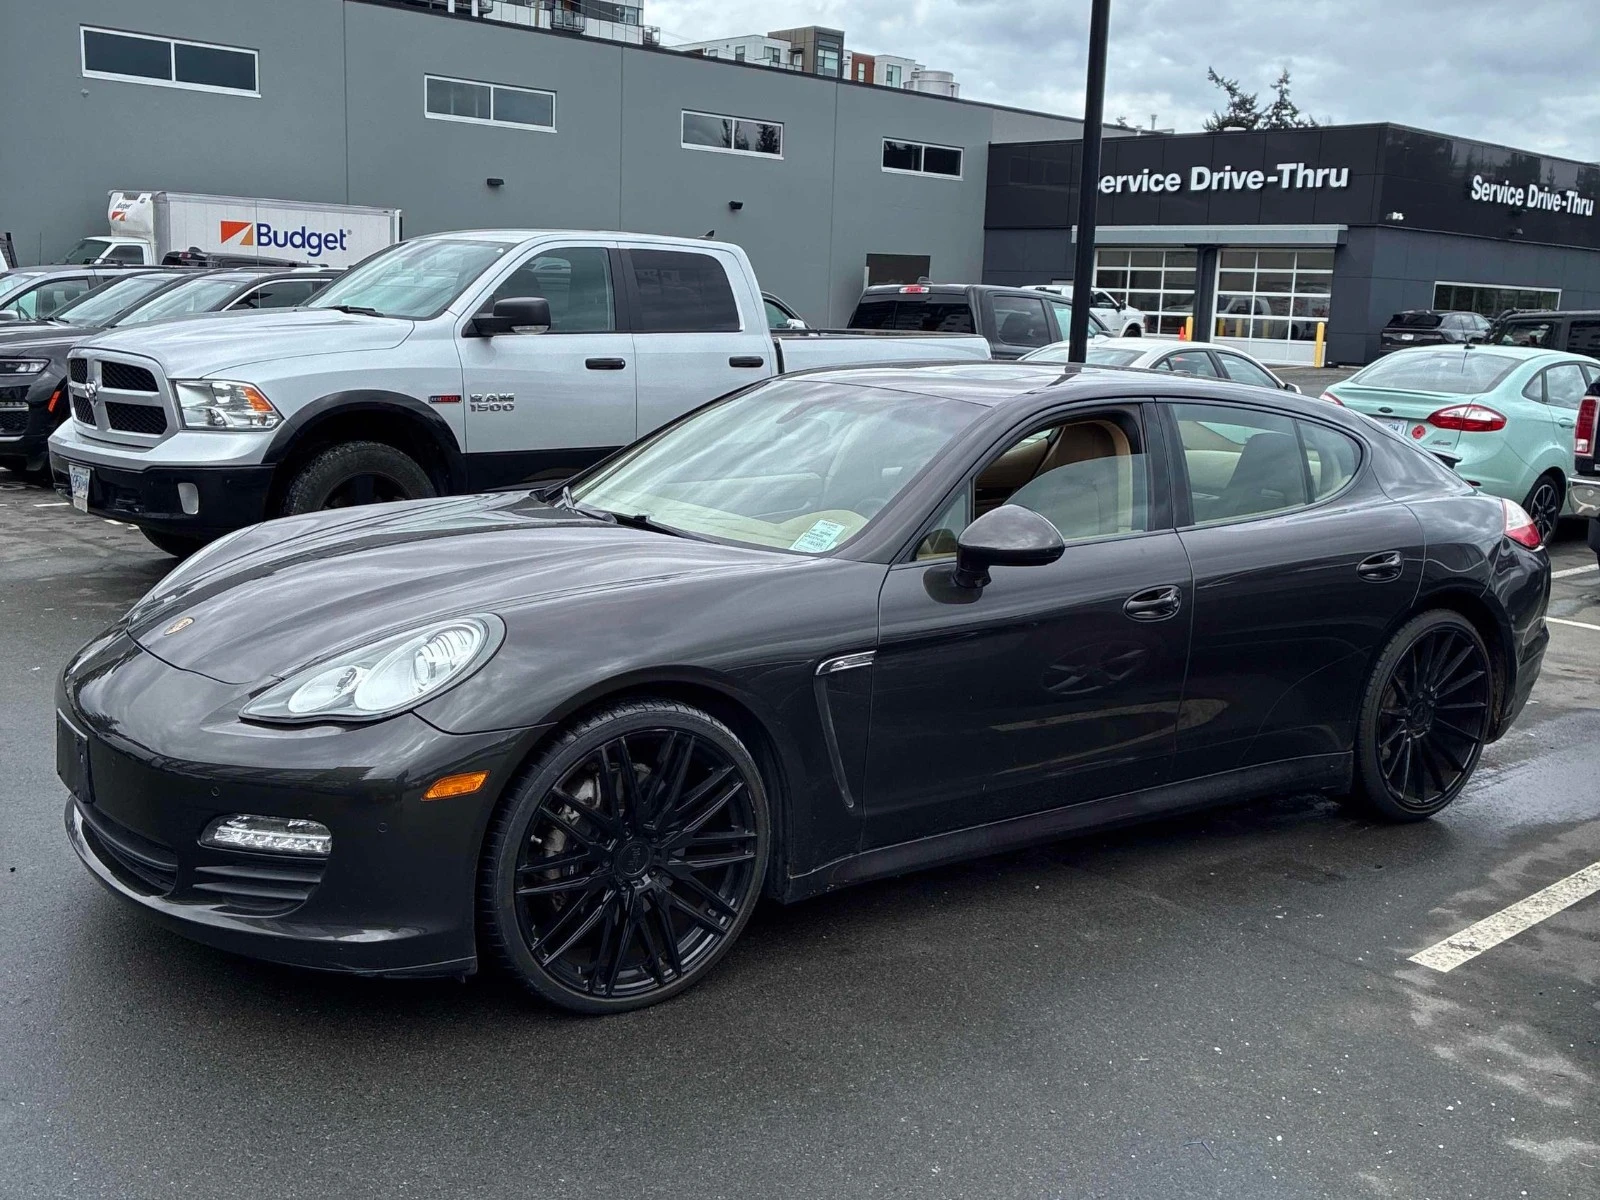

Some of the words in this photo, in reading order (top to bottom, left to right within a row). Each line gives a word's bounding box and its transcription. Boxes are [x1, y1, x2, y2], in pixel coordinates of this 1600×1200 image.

[1098, 168, 1182, 194] ervice
[1190, 162, 1349, 191] Drive-Thru
[1471, 174, 1524, 206] Service
[1526, 184, 1594, 217] Drive-Thru
[256, 222, 347, 258] Budget
[469, 392, 515, 402] RAM
[469, 402, 515, 412] 1500
